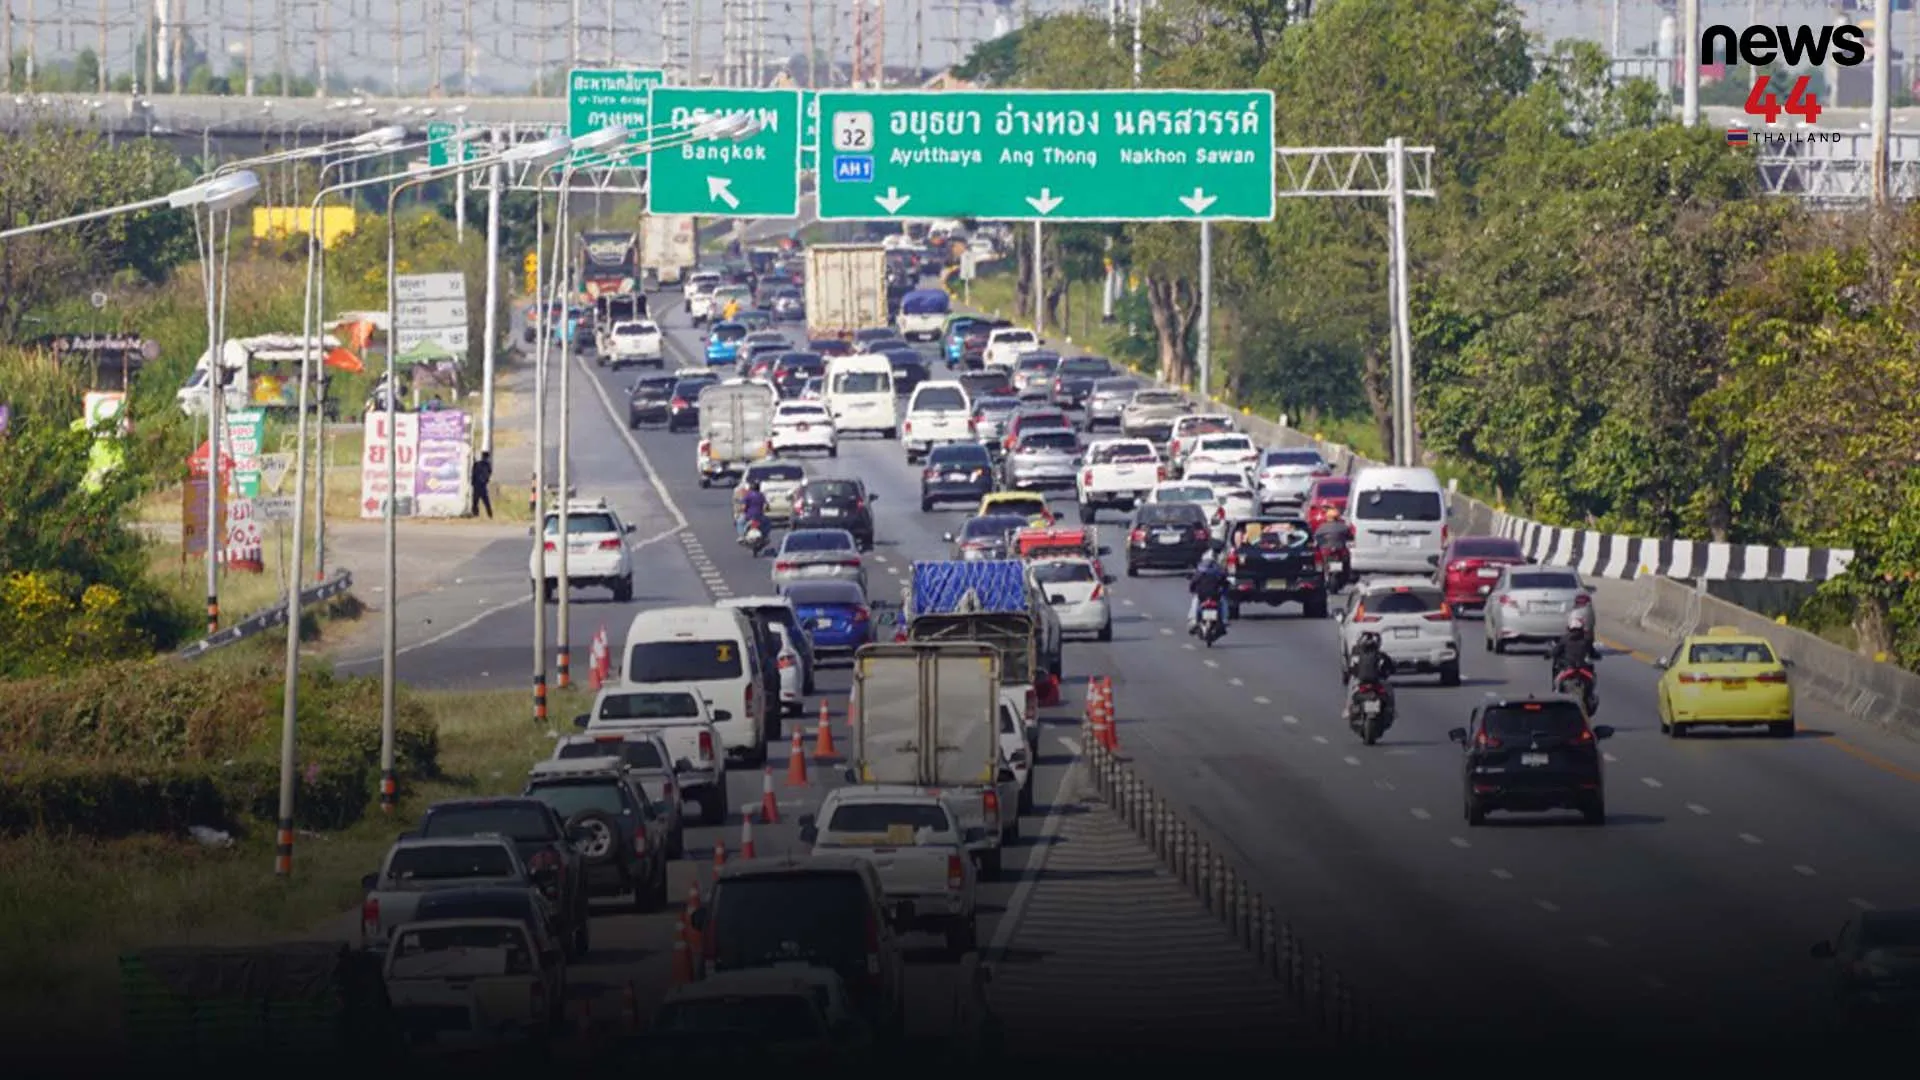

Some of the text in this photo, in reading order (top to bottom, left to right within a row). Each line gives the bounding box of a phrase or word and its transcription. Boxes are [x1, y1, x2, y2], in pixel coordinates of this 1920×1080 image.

[889, 99, 1259, 144] อยุธยา อ่างทอง นครสวรรค์
[842, 129, 866, 146] 32
[682, 144, 766, 163] Bangkok
[889, 148, 1255, 168] Ayutthaya Ang Thong Nakhon Sawan
[839, 162, 861, 176] AH
